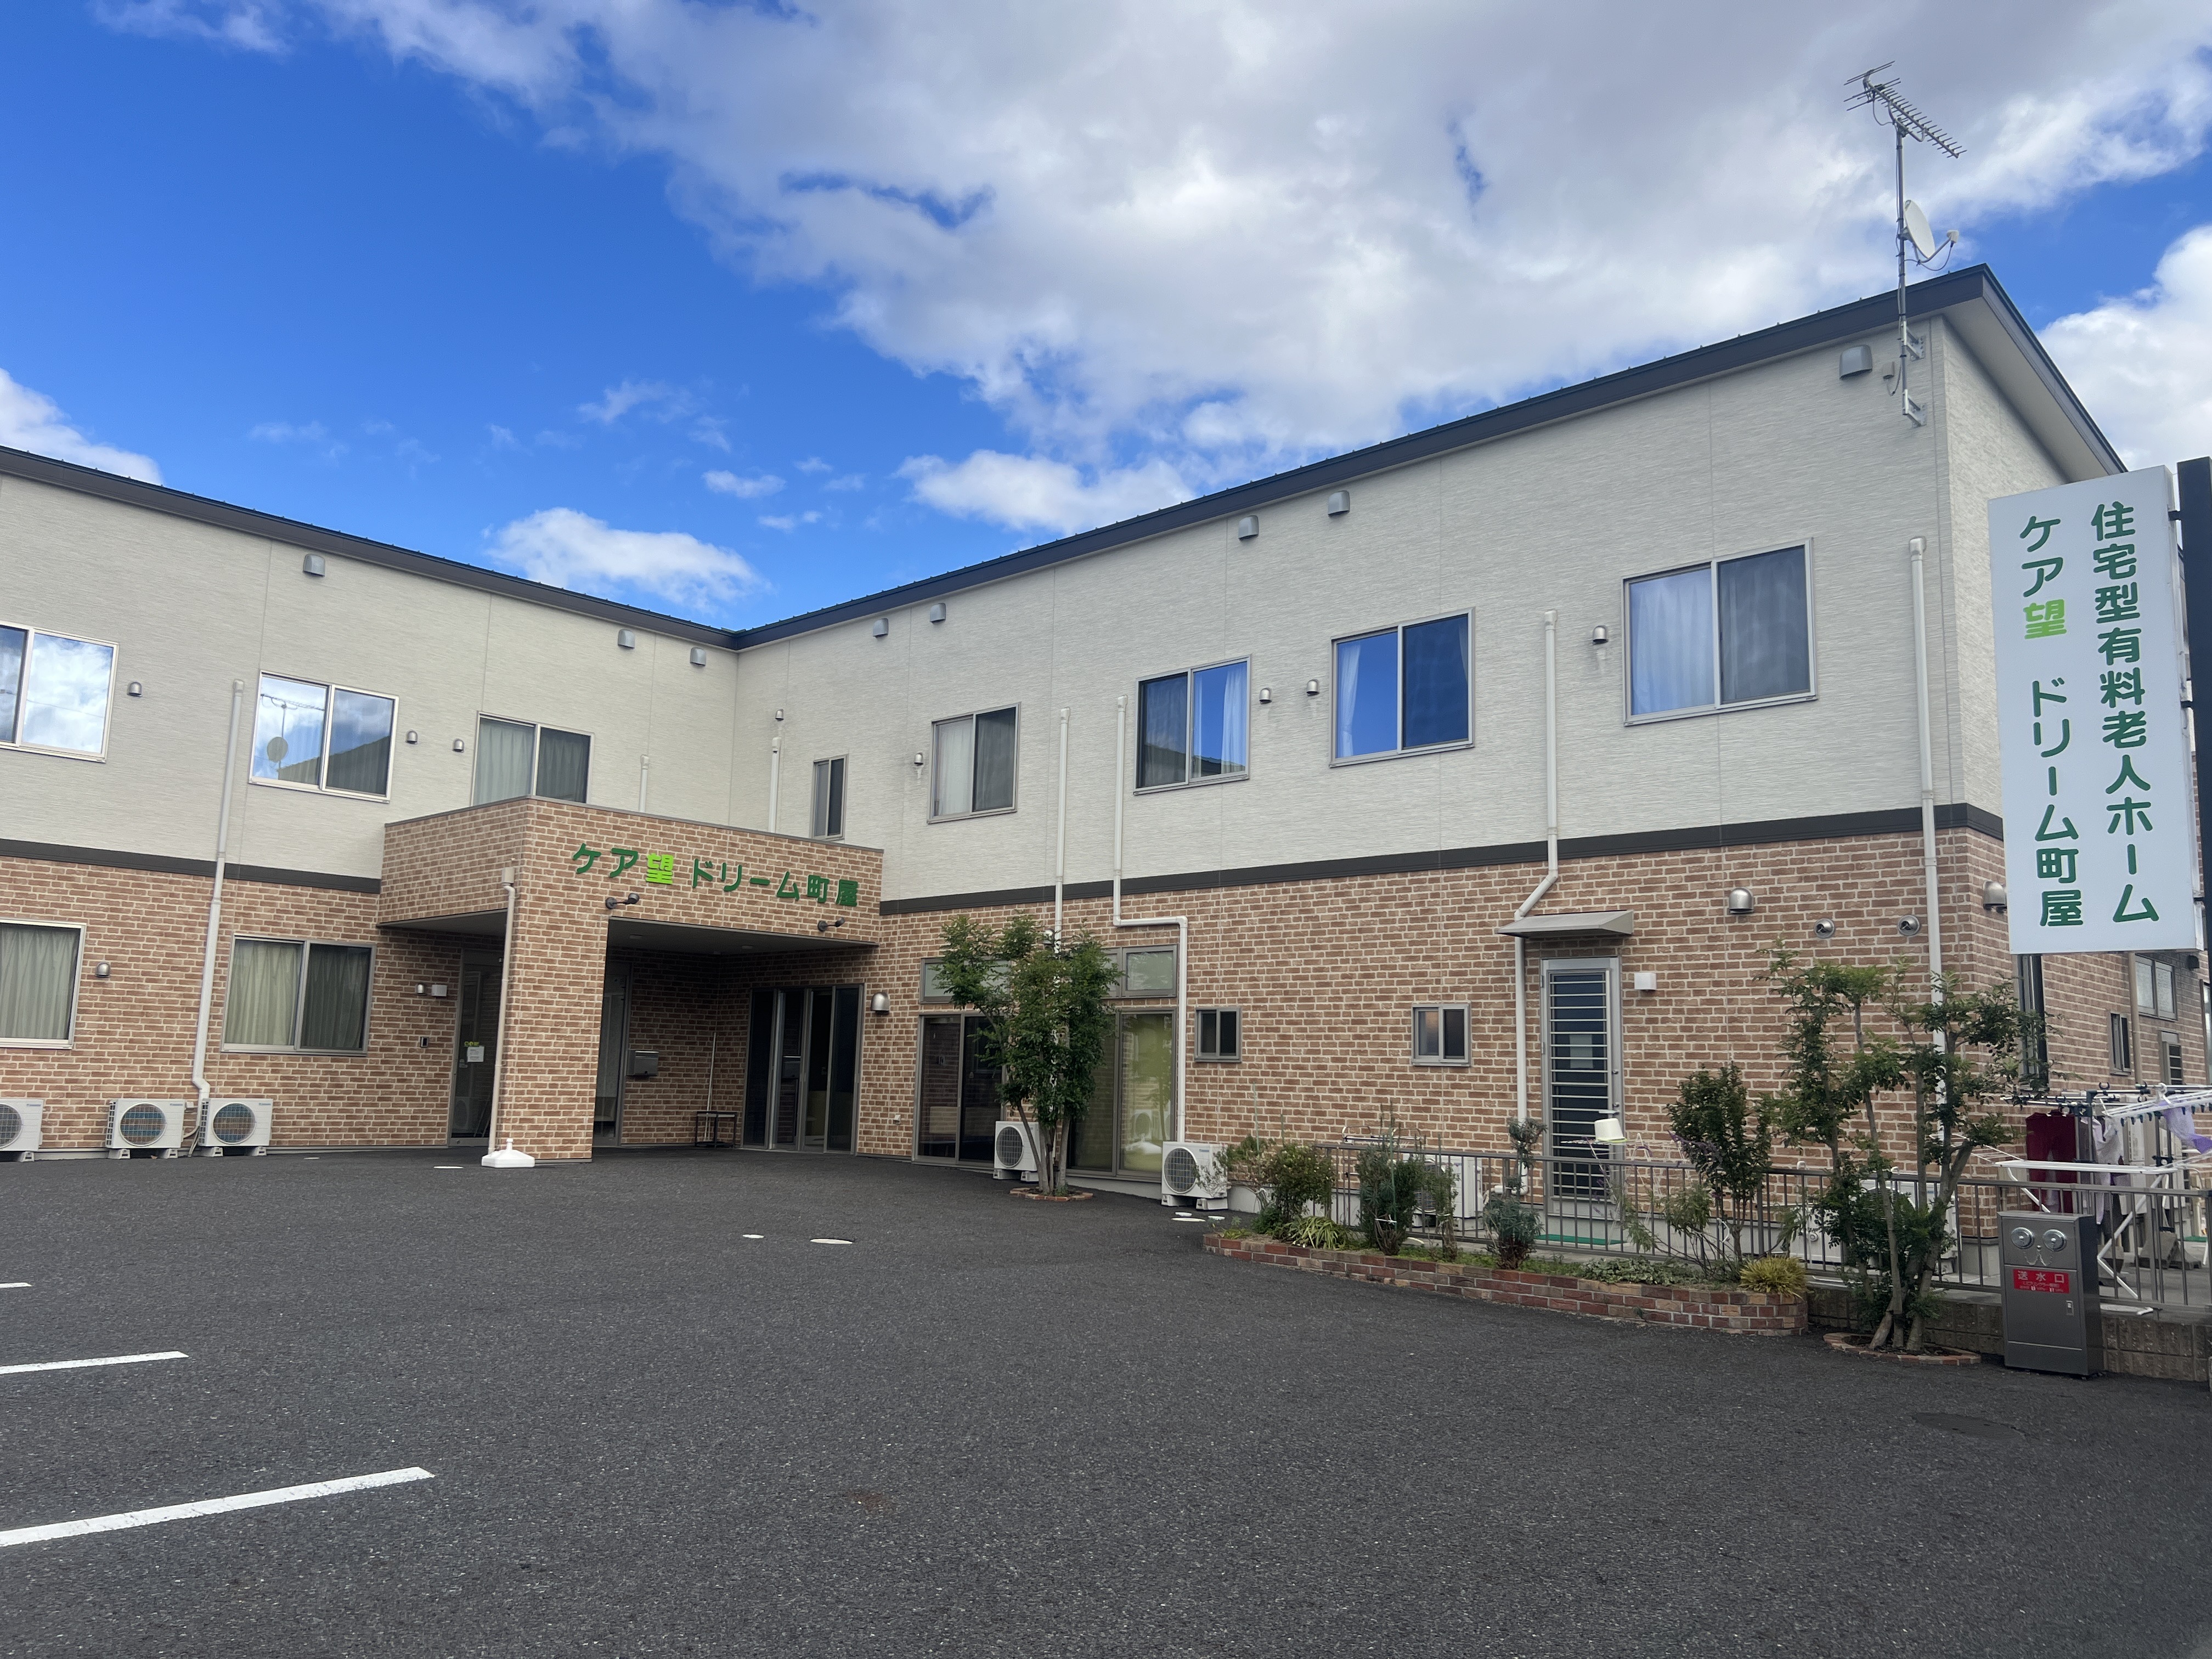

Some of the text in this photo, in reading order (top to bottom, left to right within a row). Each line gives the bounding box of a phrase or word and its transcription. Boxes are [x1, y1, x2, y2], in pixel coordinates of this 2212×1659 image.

[2019, 516, 2084, 927] ケア望 ドリーム町屋
[2091, 500, 2159, 923] 住宅型有料老人ホーム
[2017, 1270, 2064, 1284] 送水口
